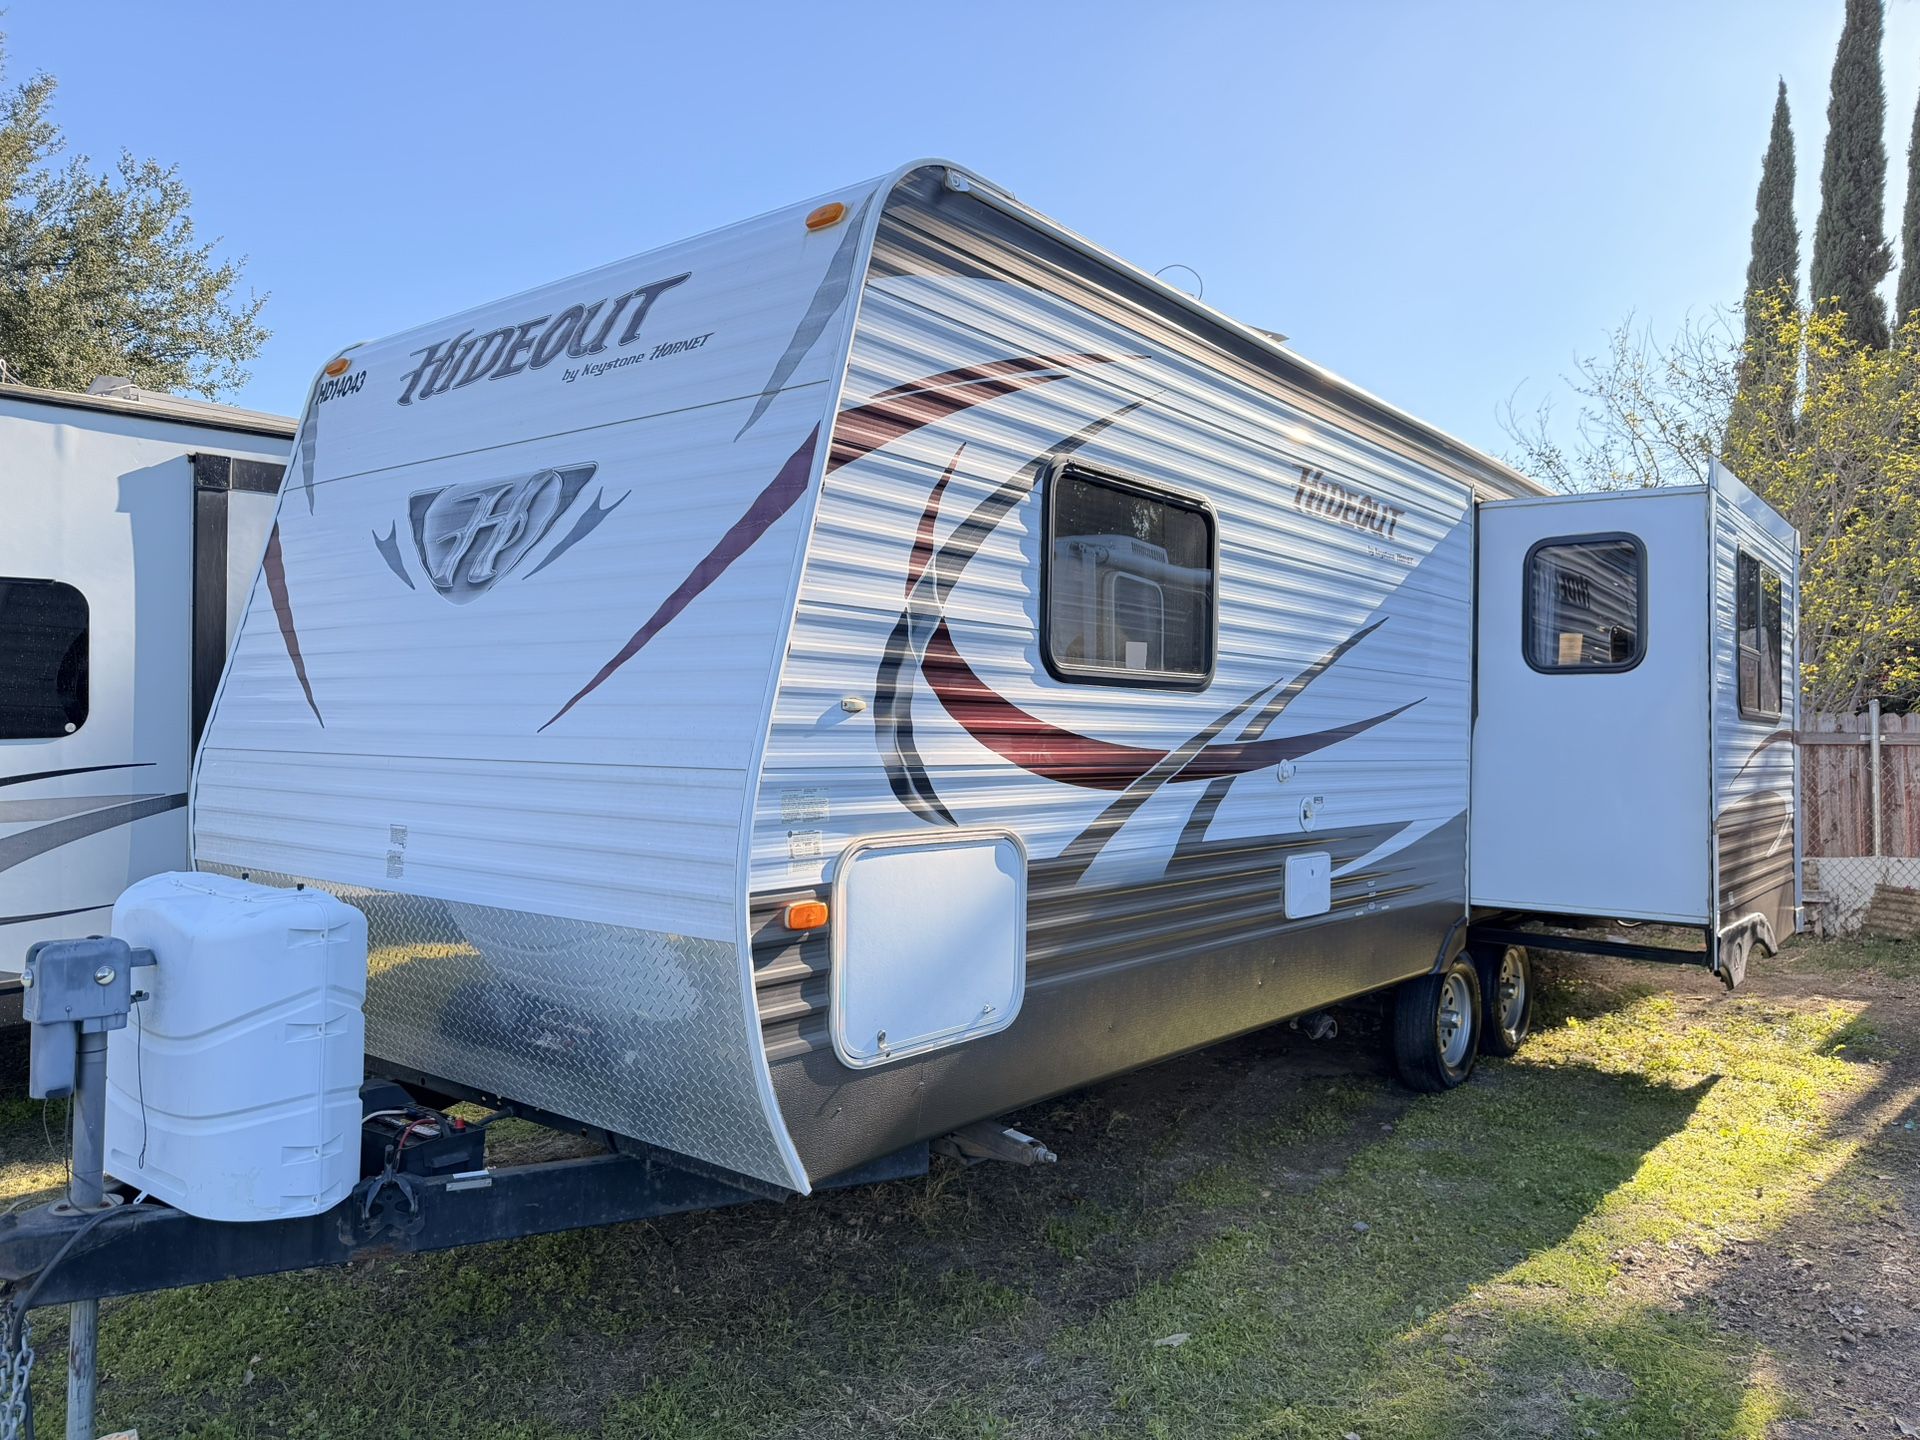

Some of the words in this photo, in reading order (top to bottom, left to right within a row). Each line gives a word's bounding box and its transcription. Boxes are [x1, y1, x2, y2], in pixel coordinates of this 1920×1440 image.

[397, 271, 692, 406] HIDEOUT
[562, 369, 579, 383] by
[581, 353, 645, 377] Keystone
[649, 331, 715, 361] HORNET
[315, 370, 367, 405] HD14043
[1292, 464, 1407, 539] HIDEOUT
